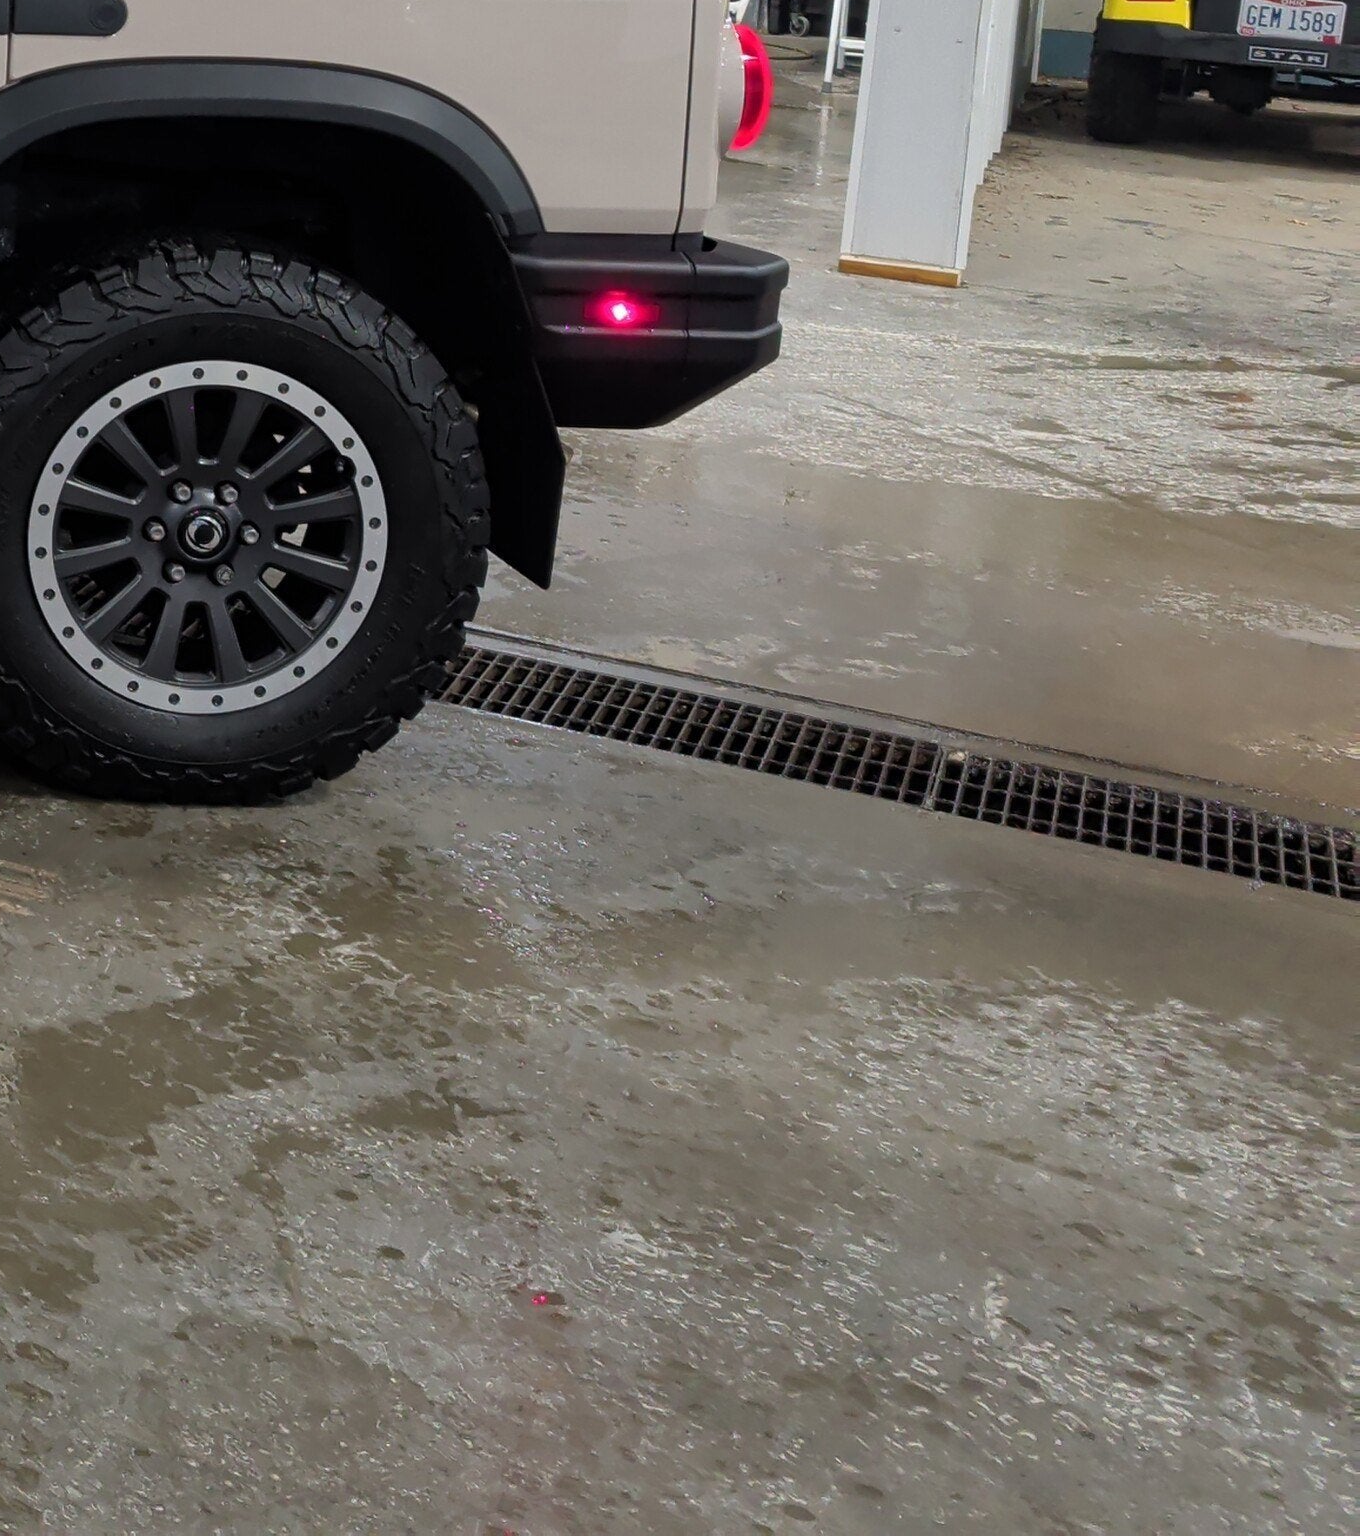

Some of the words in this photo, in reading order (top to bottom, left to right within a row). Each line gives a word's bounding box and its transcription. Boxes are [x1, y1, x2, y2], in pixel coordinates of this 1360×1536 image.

[1246, 4, 1282, 28] GEM
[1287, 10, 1336, 34] 1589
[1253, 49, 1322, 64] STAR
